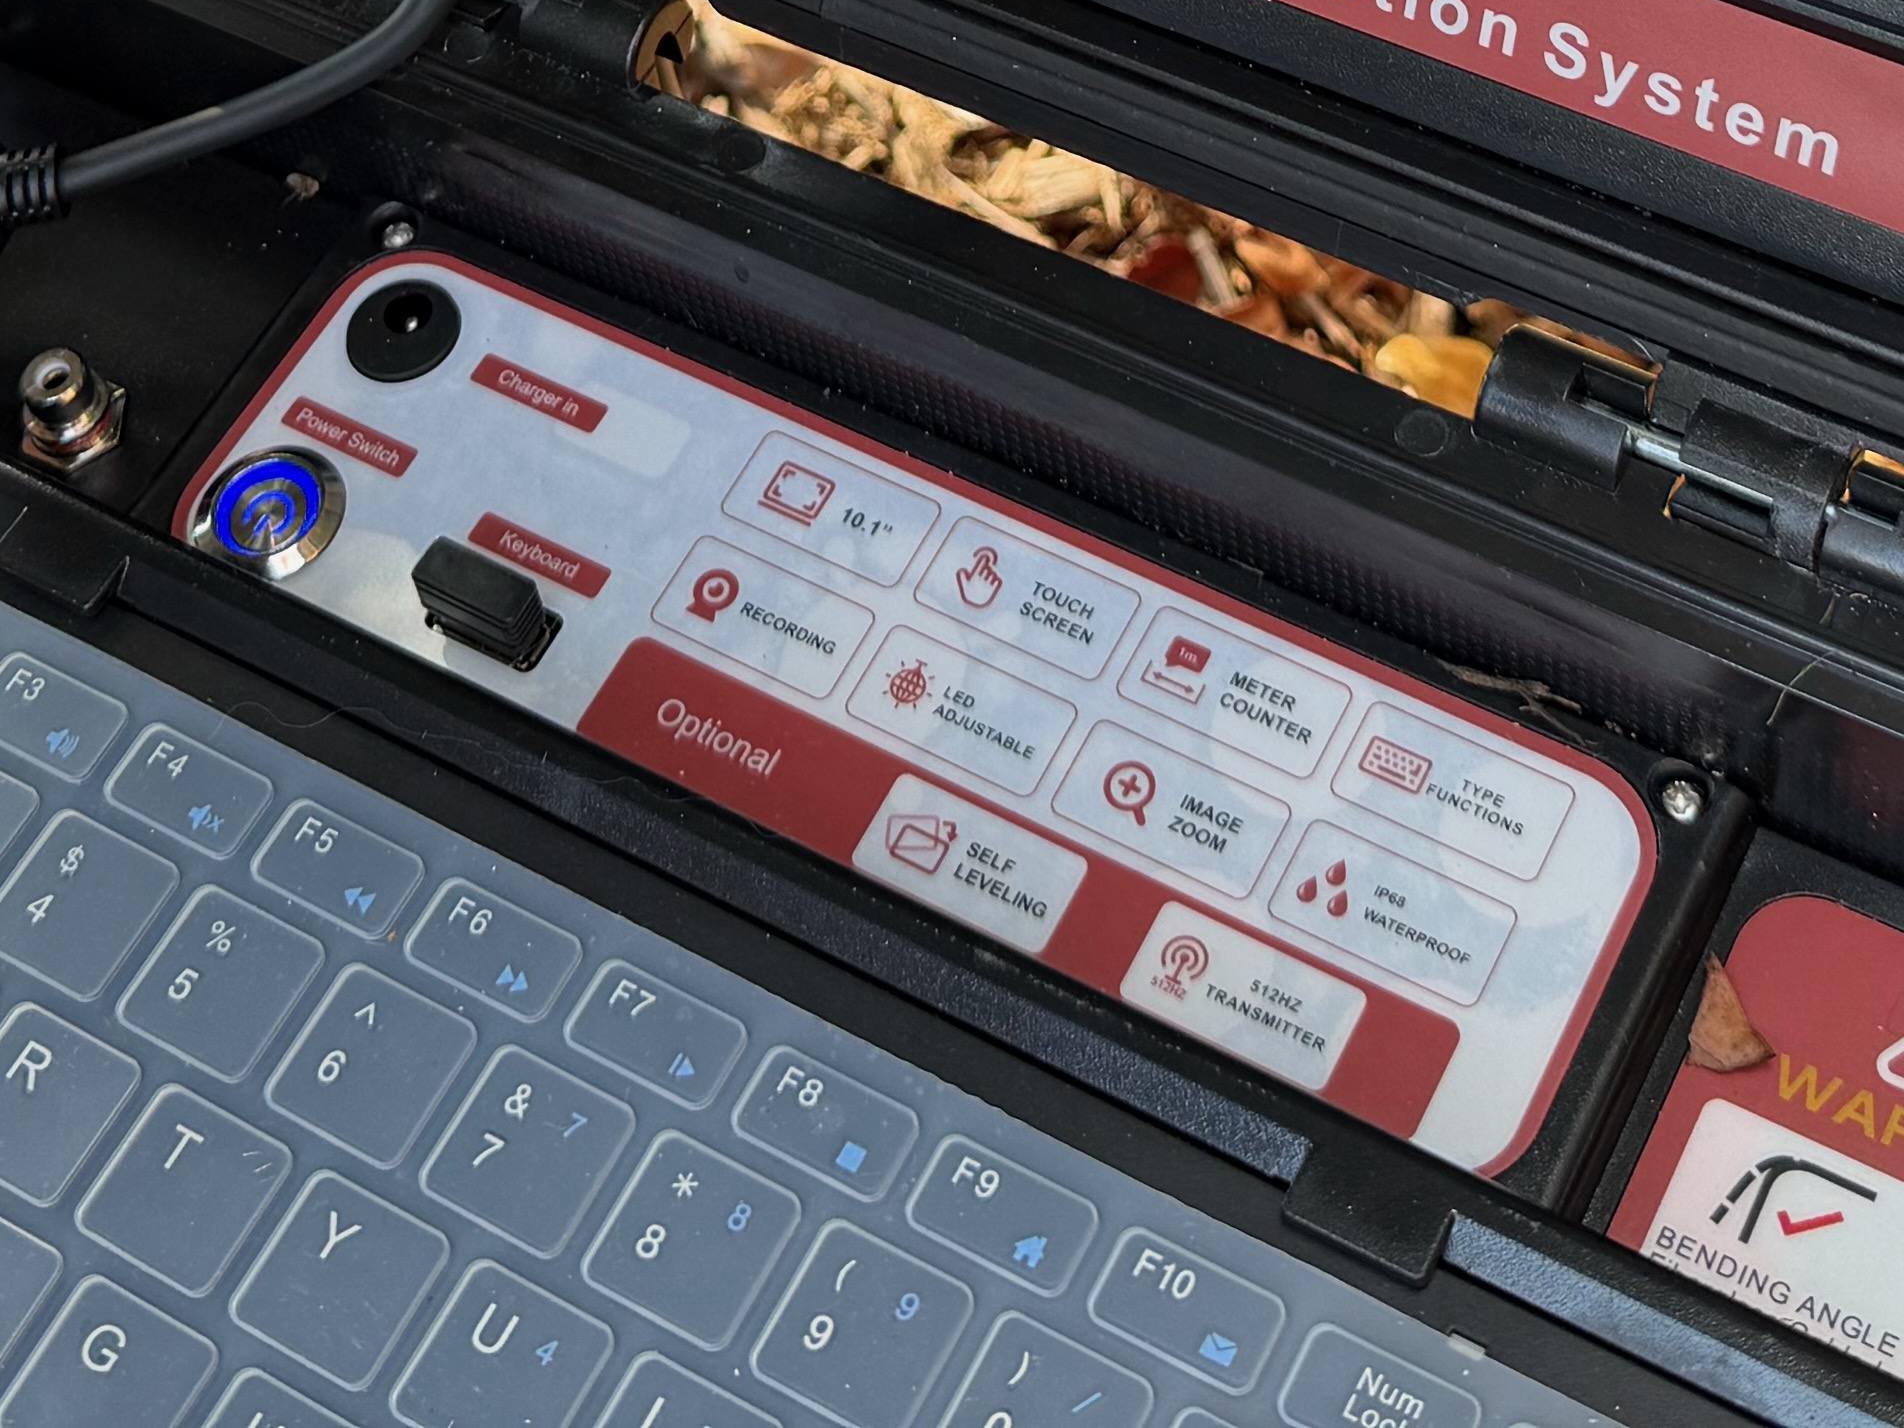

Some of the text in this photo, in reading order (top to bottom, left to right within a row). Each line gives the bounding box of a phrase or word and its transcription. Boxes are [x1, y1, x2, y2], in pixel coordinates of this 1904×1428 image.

[1543, 22, 1840, 177] System
[498, 368, 579, 416] Charger in
[295, 407, 400, 467] Power Switch
[499, 529, 581, 578] Keyboard
[1032, 580, 1095, 620] TOUCH
[740, 599, 838, 657] RECORDING
[1019, 601, 1095, 645] SCREEN
[5, 668, 45, 701] F3
[943, 685, 976, 708] LED
[1229, 671, 1297, 712] METER
[656, 698, 783, 778] Optional
[932, 704, 1036, 760] ADJUSTABLE
[1219, 692, 1313, 745] COUNTER
[147, 740, 189, 778] F4
[1179, 793, 1244, 835] IMAGE
[1425, 782, 1524, 836] FUNCTIONS
[1461, 778, 1506, 809] TYPE
[292, 815, 339, 853] F5
[1167, 815, 1228, 854] ZOOM
[59, 844, 86, 877] $
[966, 841, 1017, 873] SELF
[25, 893, 56, 925] 4
[953, 862, 1048, 918] LEVELING
[1373, 884, 1407, 908] IP68
[446, 896, 493, 936] F6
[1363, 906, 1472, 965] WATERPROOF
[206, 919, 233, 955] %
[168, 968, 200, 1000] 5
[607, 977, 658, 1019] F7
[1149, 975, 1189, 1001] 512HZ
[1250, 978, 1303, 1014] 512HZ
[1205, 983, 1327, 1052] TRANSMITTER
[4, 1040, 53, 1091] R
[317, 1049, 347, 1084] 6
[504, 1082, 532, 1121] &
[775, 1064, 825, 1109] F8
[563, 1112, 588, 1138] 7
[161, 1122, 205, 1170] T
[472, 1132, 505, 1167] 7
[950, 1156, 1001, 1199] F9
[318, 1210, 362, 1260] Y
[726, 1203, 752, 1232] 8
[635, 1224, 667, 1260] 8
[1131, 1248, 1197, 1301] F10
[1655, 1225, 1791, 1305] BENDING
[1795, 1295, 1901, 1358] ANGLE
[895, 1293, 921, 1322] 9
[80, 1323, 128, 1374] G
[471, 1303, 520, 1355] U
[802, 1315, 835, 1351] 9
[536, 1340, 559, 1366] 4
[1355, 1366, 1425, 1420] Num
